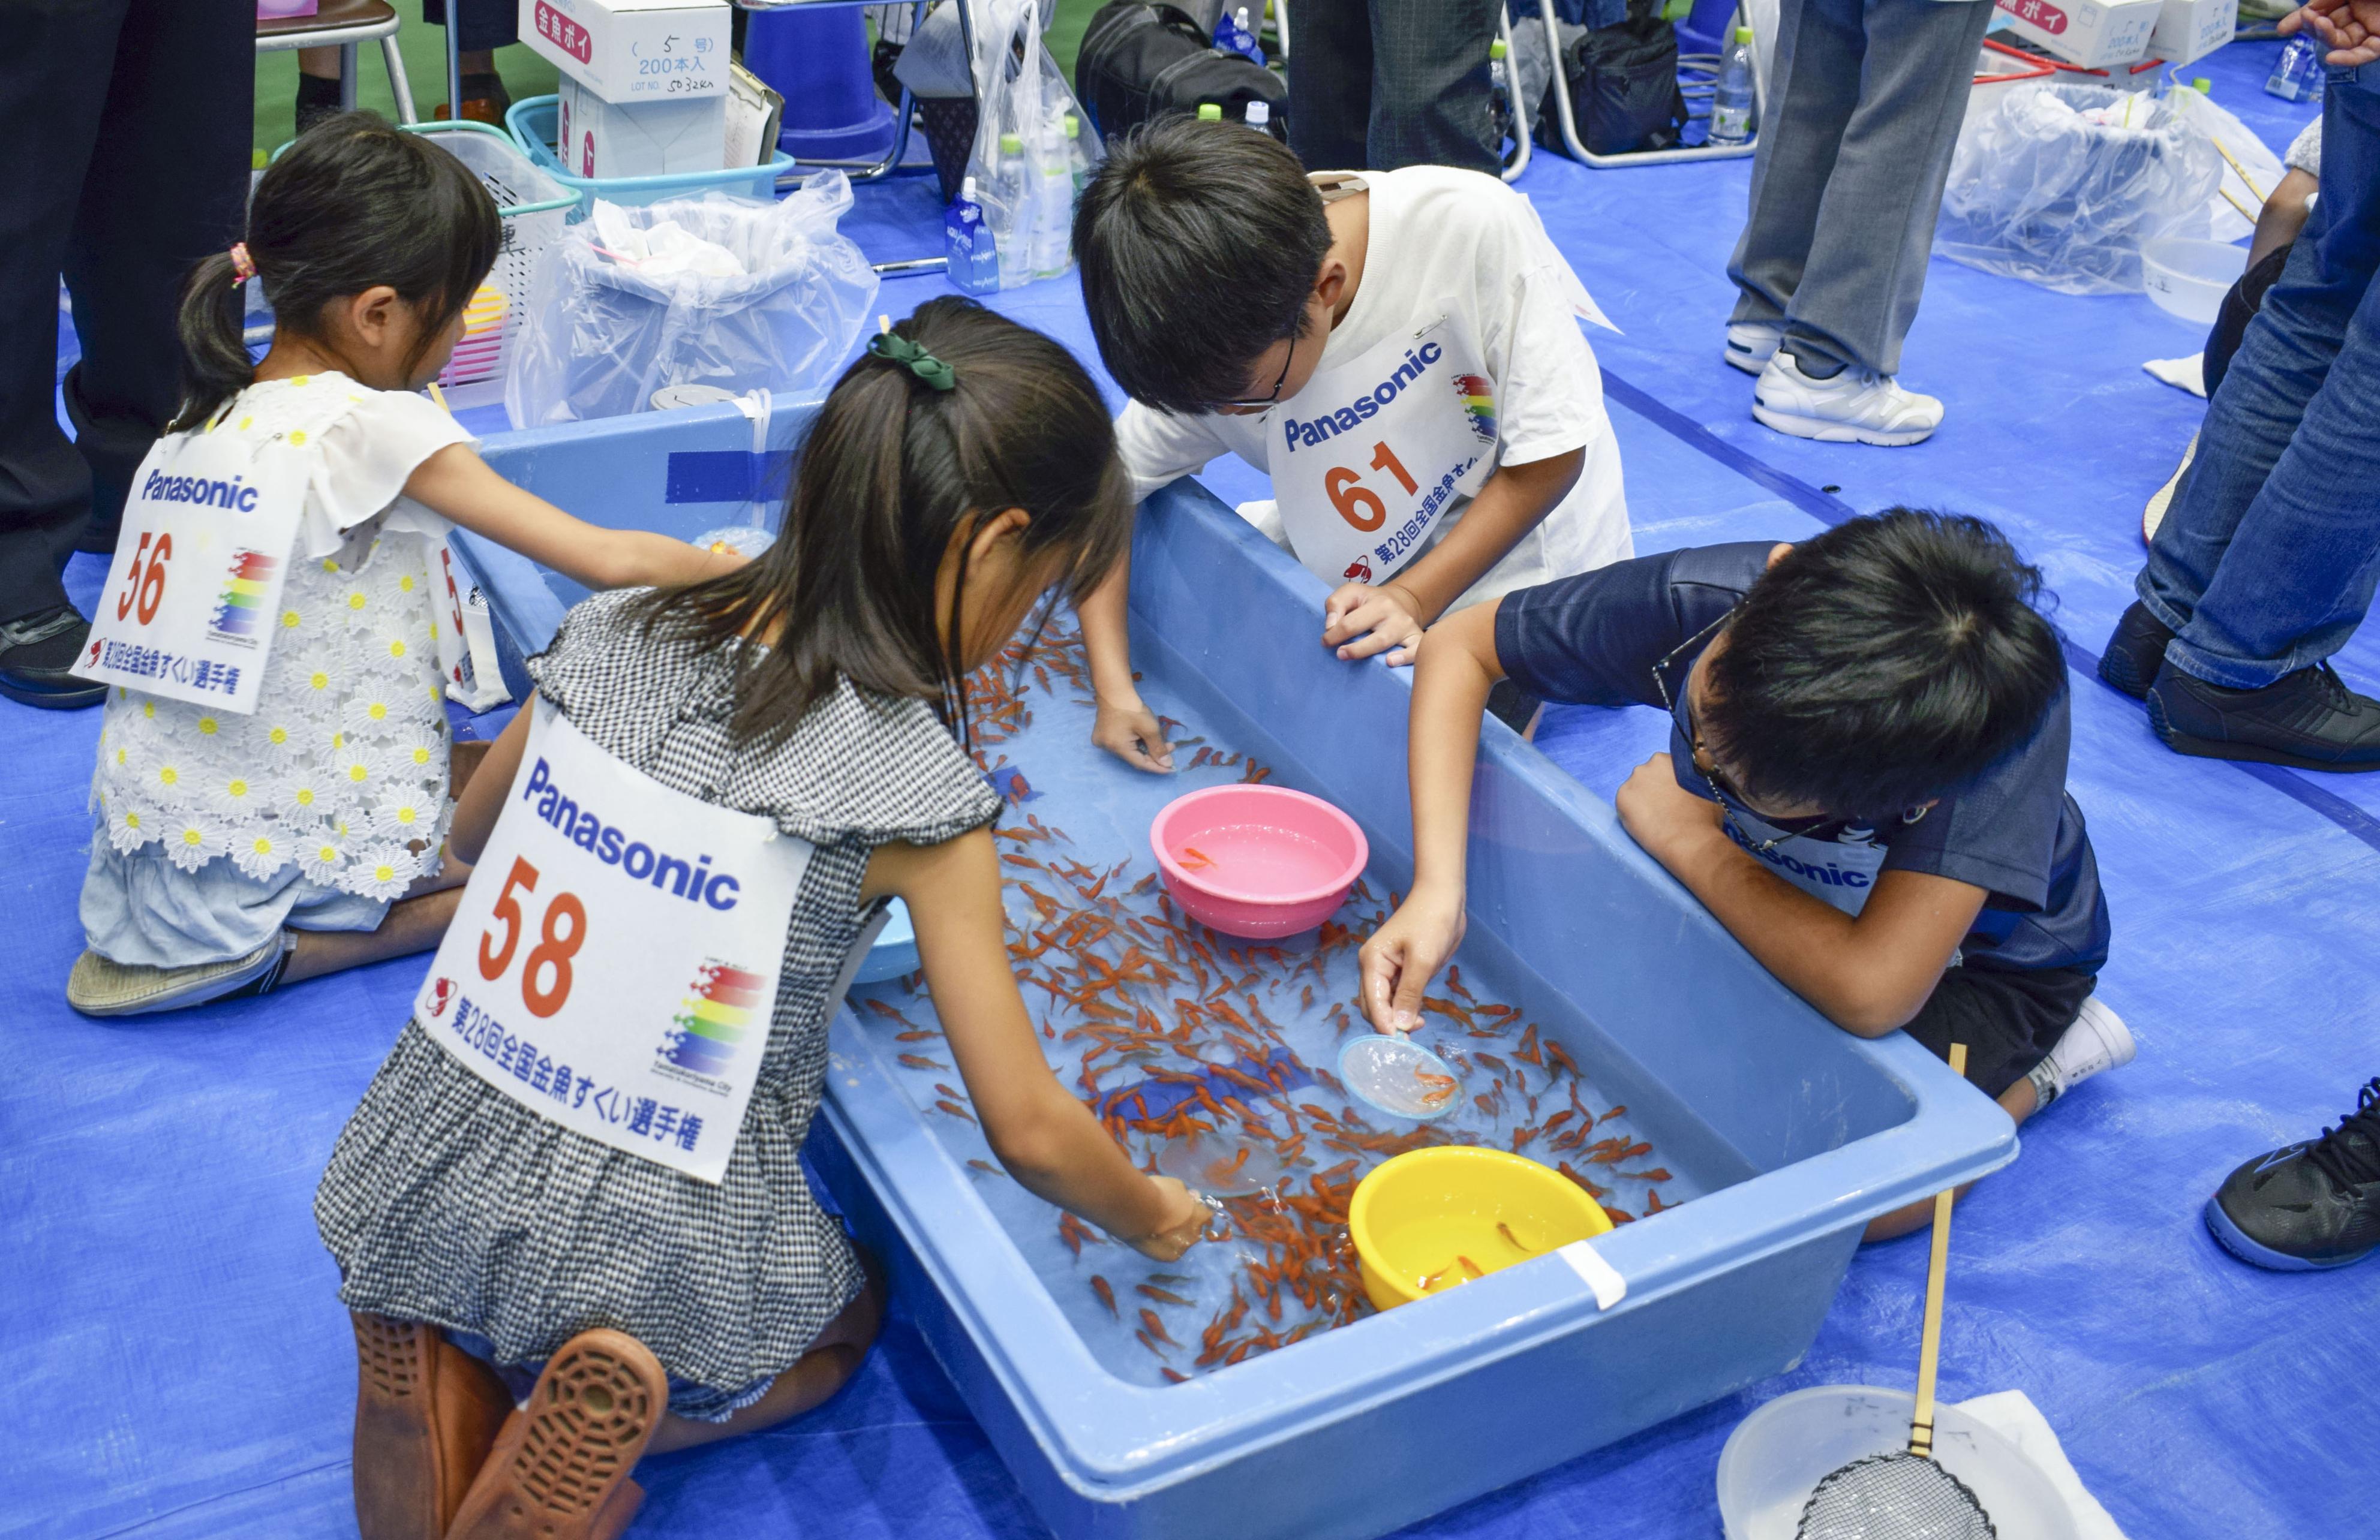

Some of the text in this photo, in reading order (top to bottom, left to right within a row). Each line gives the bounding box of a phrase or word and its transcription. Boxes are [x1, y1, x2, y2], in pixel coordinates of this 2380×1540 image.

[539, 6, 587, 58] 金魚ポイ
[639, 56, 705, 75] 200本入
[663, 35, 680, 53] 5
[631, 82, 645, 91] LOT
[1285, 342, 1442, 452] Panasonic
[142, 469, 259, 513] Panasonic
[1324, 441, 1419, 532] 61
[118, 533, 172, 625] 56
[102, 640, 241, 695] 第28回全国金魚すくい選手権
[524, 756, 740, 911] Panasonic
[478, 855, 587, 1018] 58
[452, 995, 703, 1152] 第28回全国金魚すくい選手権
